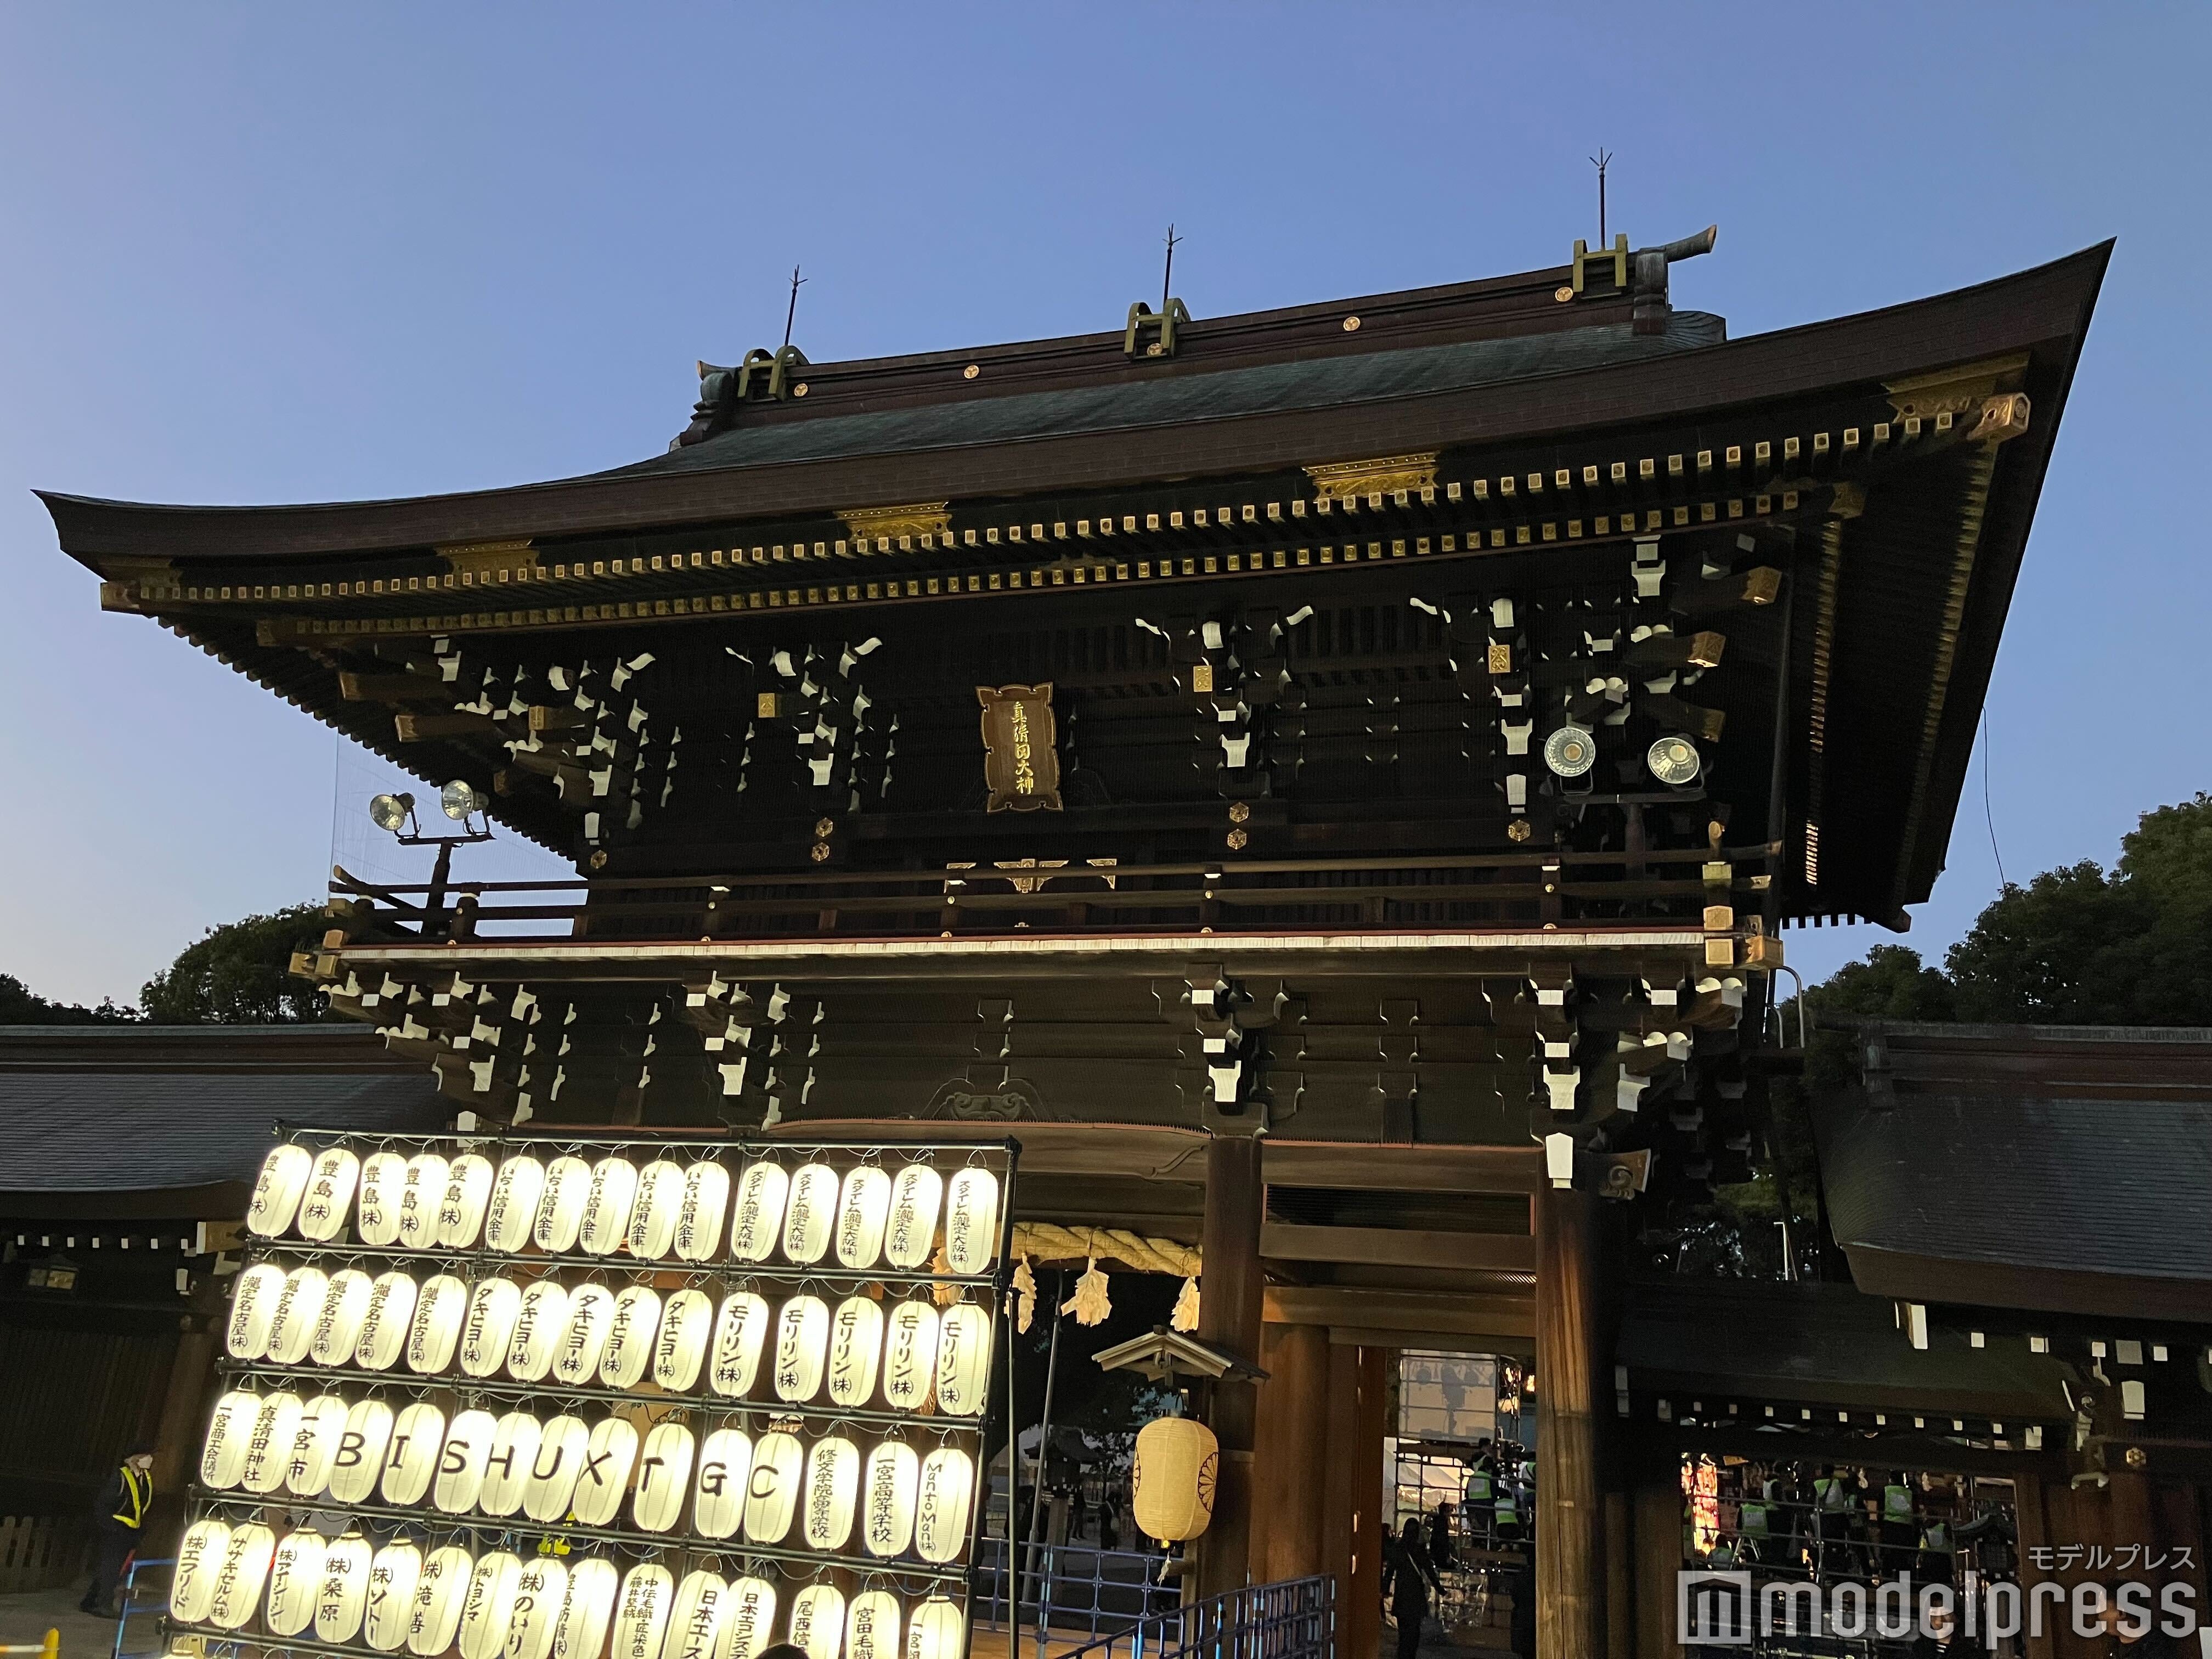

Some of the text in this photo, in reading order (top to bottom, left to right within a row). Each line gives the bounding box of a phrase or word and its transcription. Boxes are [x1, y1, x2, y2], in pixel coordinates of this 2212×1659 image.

[488, 1167, 515, 1242] いちい信用金庫
[537, 1166, 562, 1240] いちい信用金庫
[582, 1167, 606, 1242] いちい信用金庫
[631, 1171, 657, 1247] いちい信用金庫
[678, 1172, 701, 1249] いちい信用金庫
[244, 1406, 277, 1481] 真清田神社
[289, 1416, 319, 1480] 一宮市
[872, 1459, 895, 1542] 一宮高等学校
